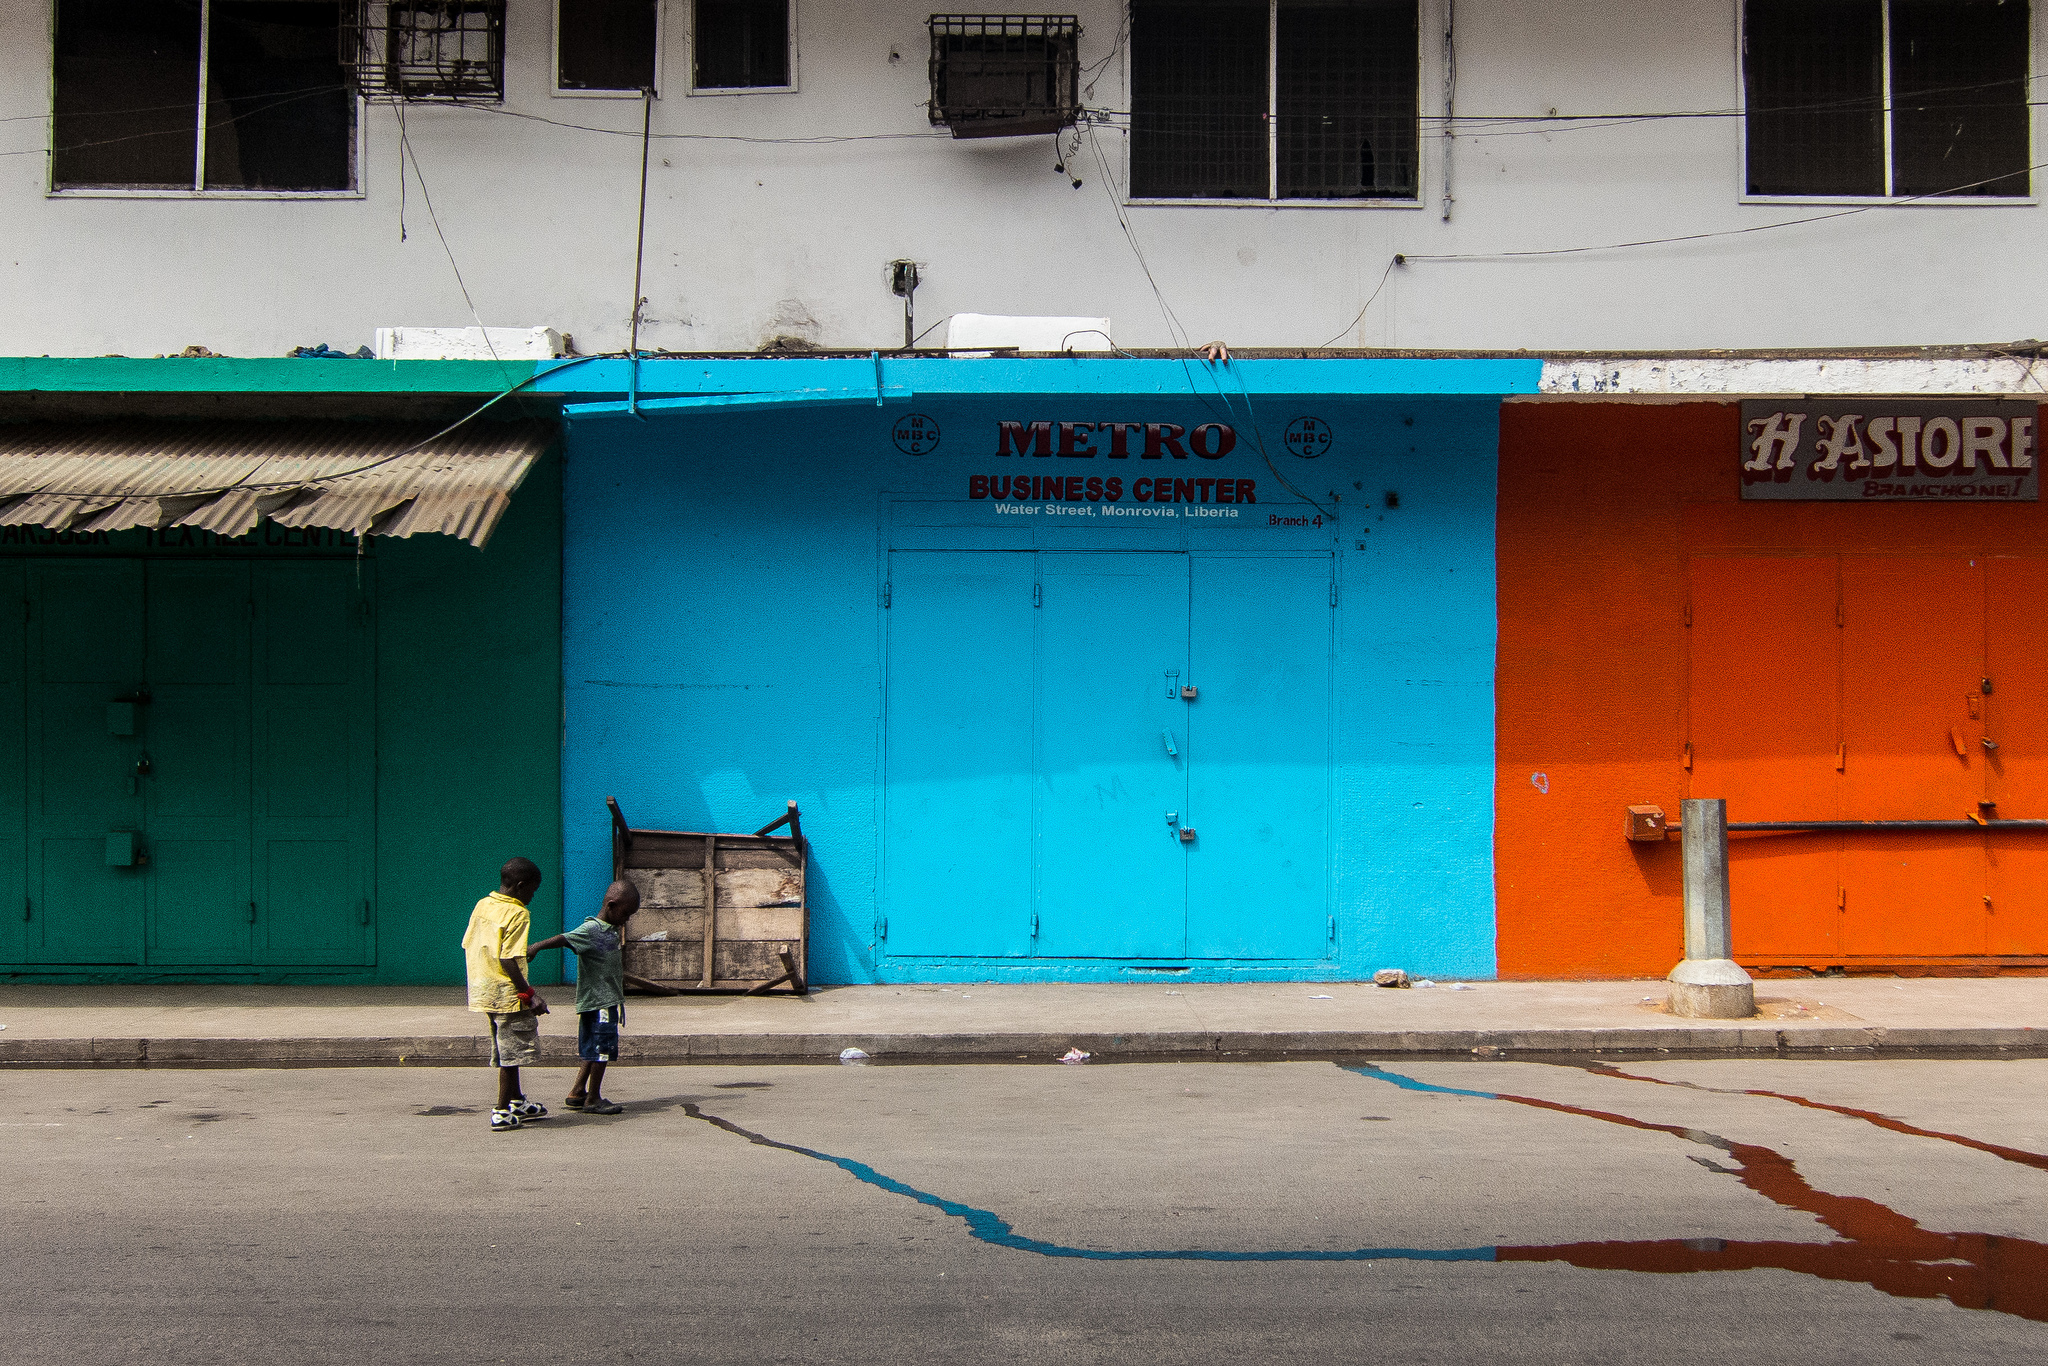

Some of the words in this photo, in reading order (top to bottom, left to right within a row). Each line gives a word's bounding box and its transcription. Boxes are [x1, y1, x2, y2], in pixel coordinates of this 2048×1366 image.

[995, 420, 1237, 460] METRO
[1744, 412, 1807, 472] H
[968, 474, 1124, 501] BUSINESS
[1132, 477, 1257, 504] CENTER
[995, 503, 1041, 516] Water
[1045, 504, 1097, 518] Street,
[1101, 505, 1180, 519] Monrovia,
[1184, 507, 1239, 518] Liberia
[1268, 513, 1310, 528] Branch
[1311, 514, 1324, 530] 4
[264, 516, 376, 548] CEN
